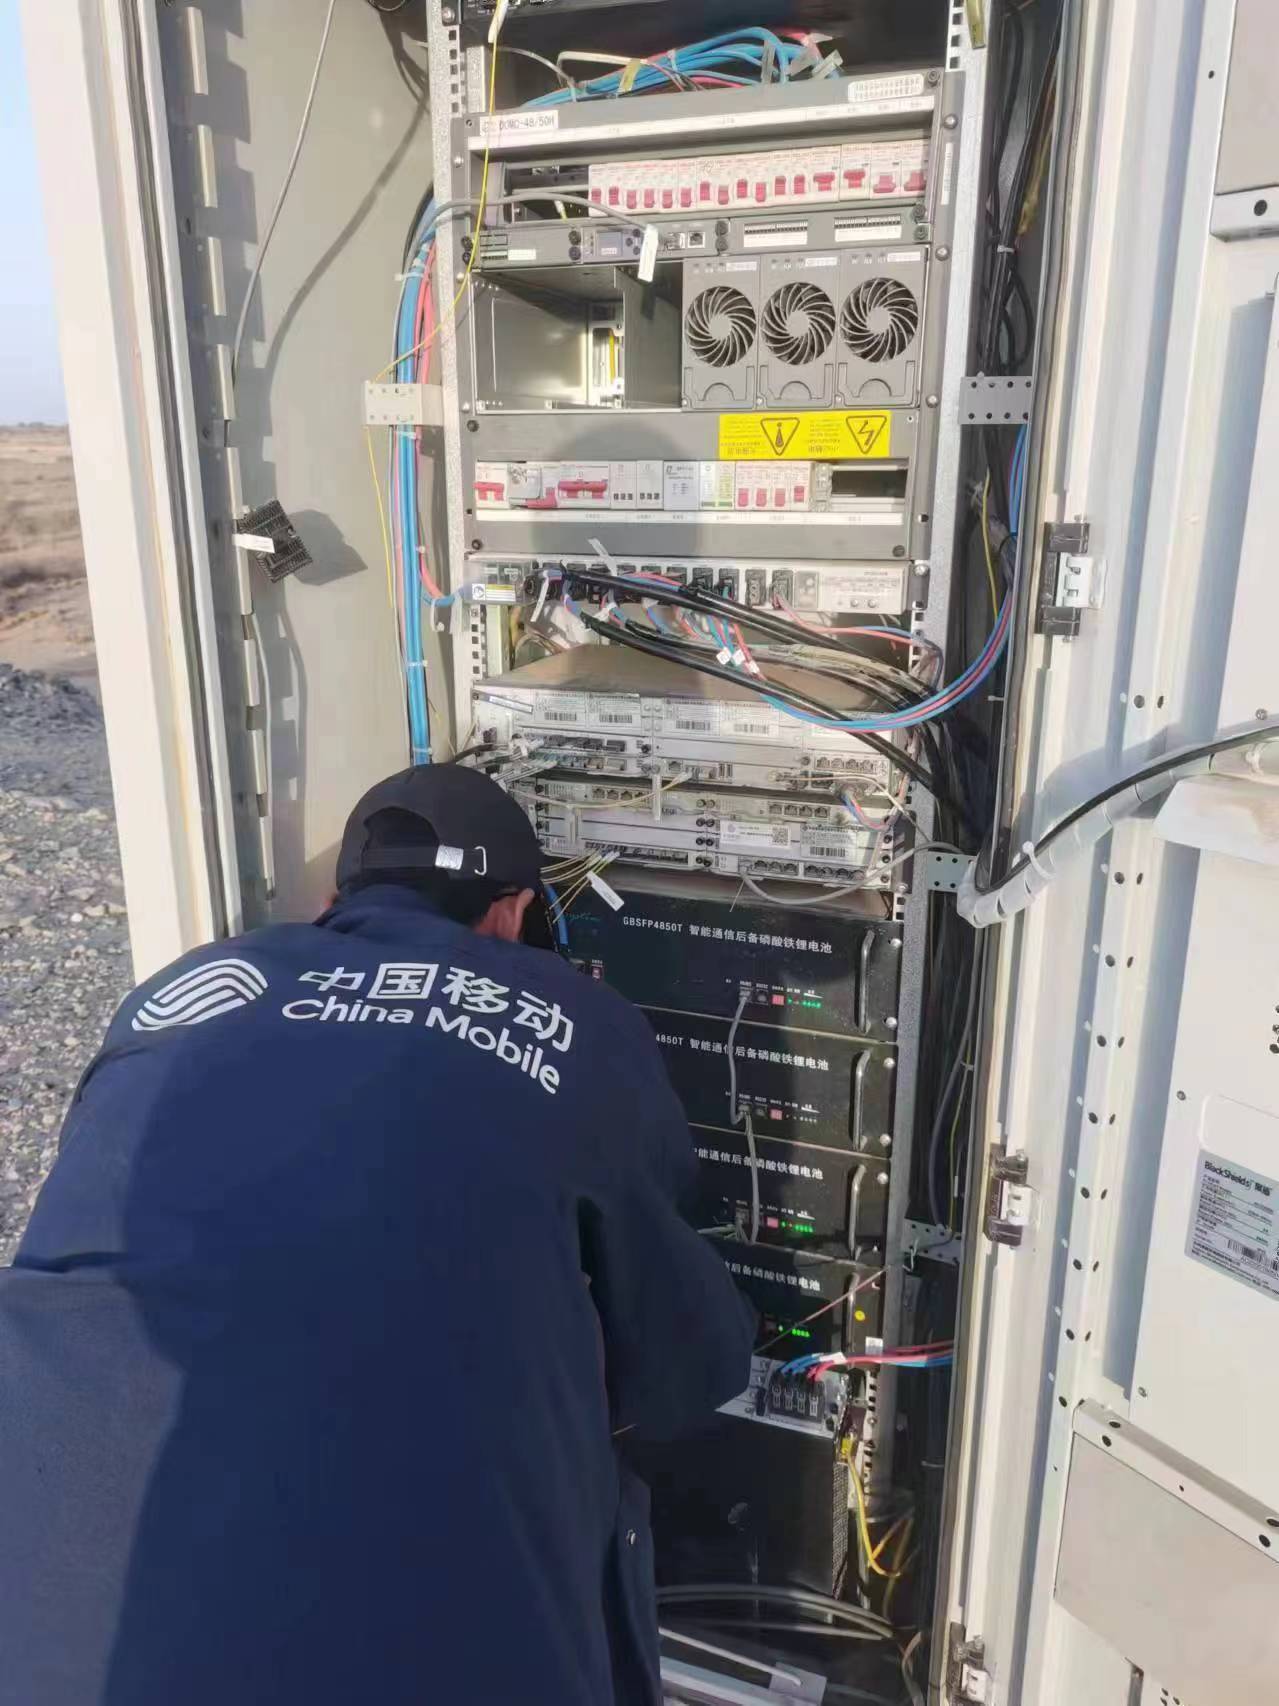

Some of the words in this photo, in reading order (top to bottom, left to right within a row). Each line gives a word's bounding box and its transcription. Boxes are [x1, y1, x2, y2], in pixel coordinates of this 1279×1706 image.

[623, 916, 683, 932] GBSFP4850T
[688, 924, 833, 954] 智能通信后备磷酸铁锂电池
[298, 963, 575, 1053] 中国移动
[281, 996, 415, 1025] China
[425, 1007, 561, 1095] Mobile
[694, 1147, 824, 1180] 能通信后备磷酸铁锂电池
